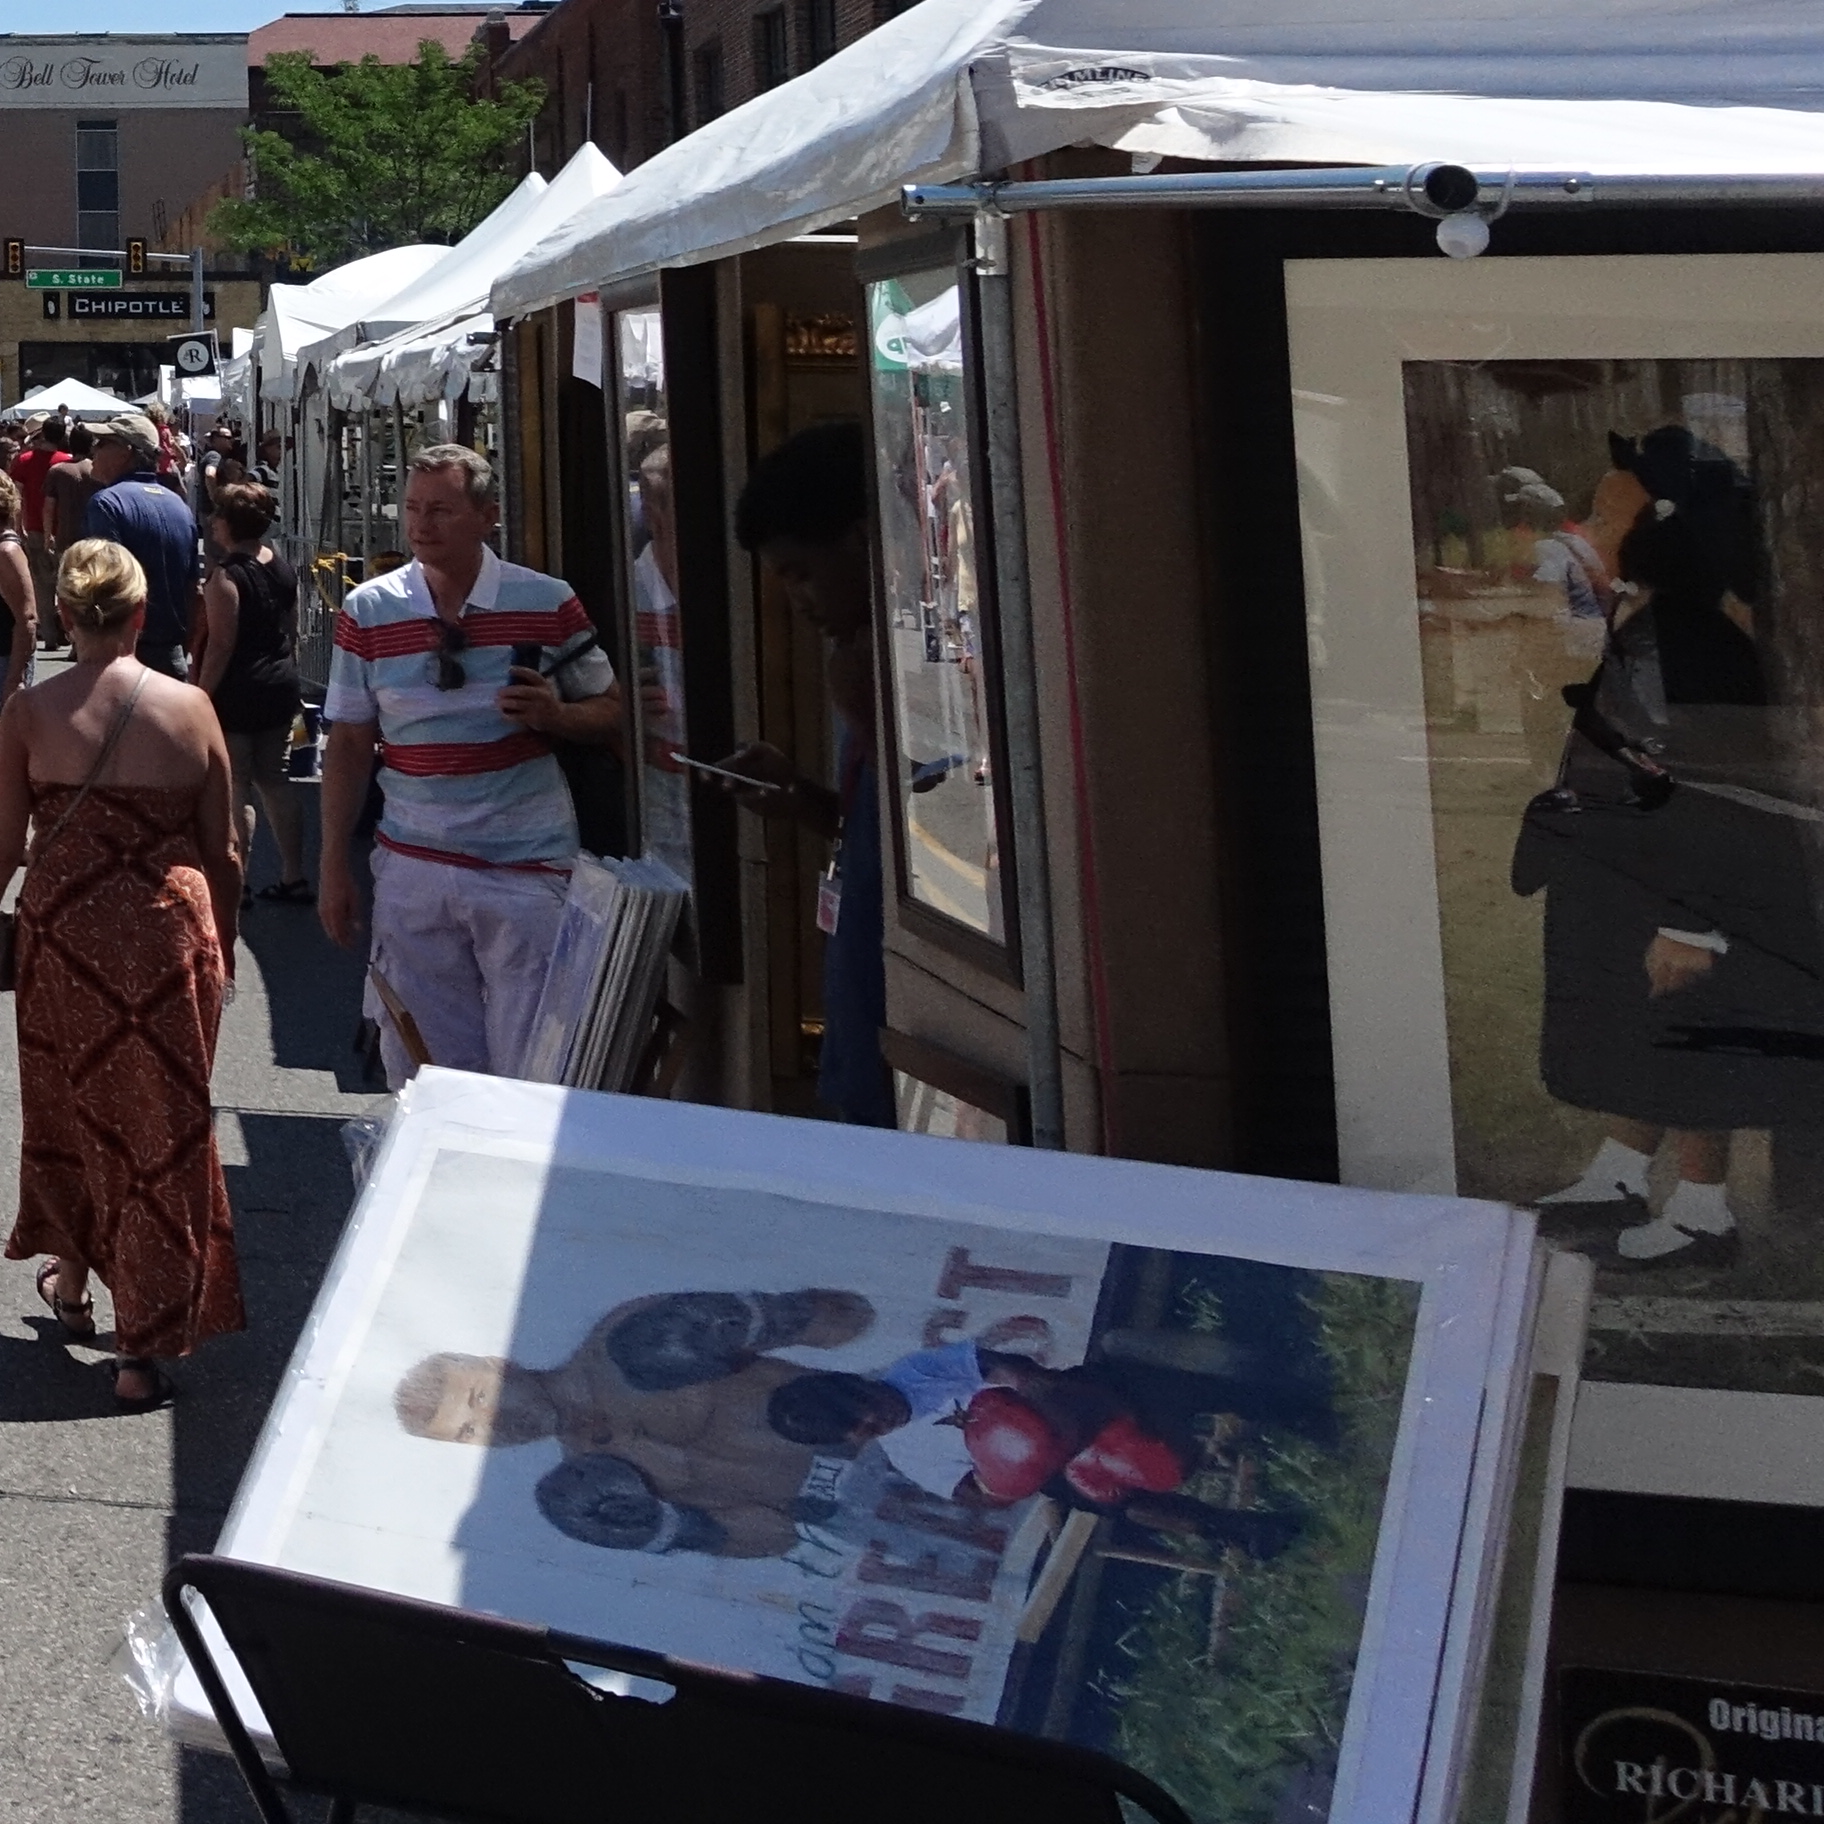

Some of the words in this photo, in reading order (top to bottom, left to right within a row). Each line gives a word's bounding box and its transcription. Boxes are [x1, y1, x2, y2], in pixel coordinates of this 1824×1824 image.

[60, 56, 125, 90] Tower
[133, 57, 200, 90] Hotel
[52, 274, 64, 285] S.
[68, 274, 105, 285] State
[75, 298, 184, 314] CHIPOTLE
[782, 1514, 844, 1580] th
